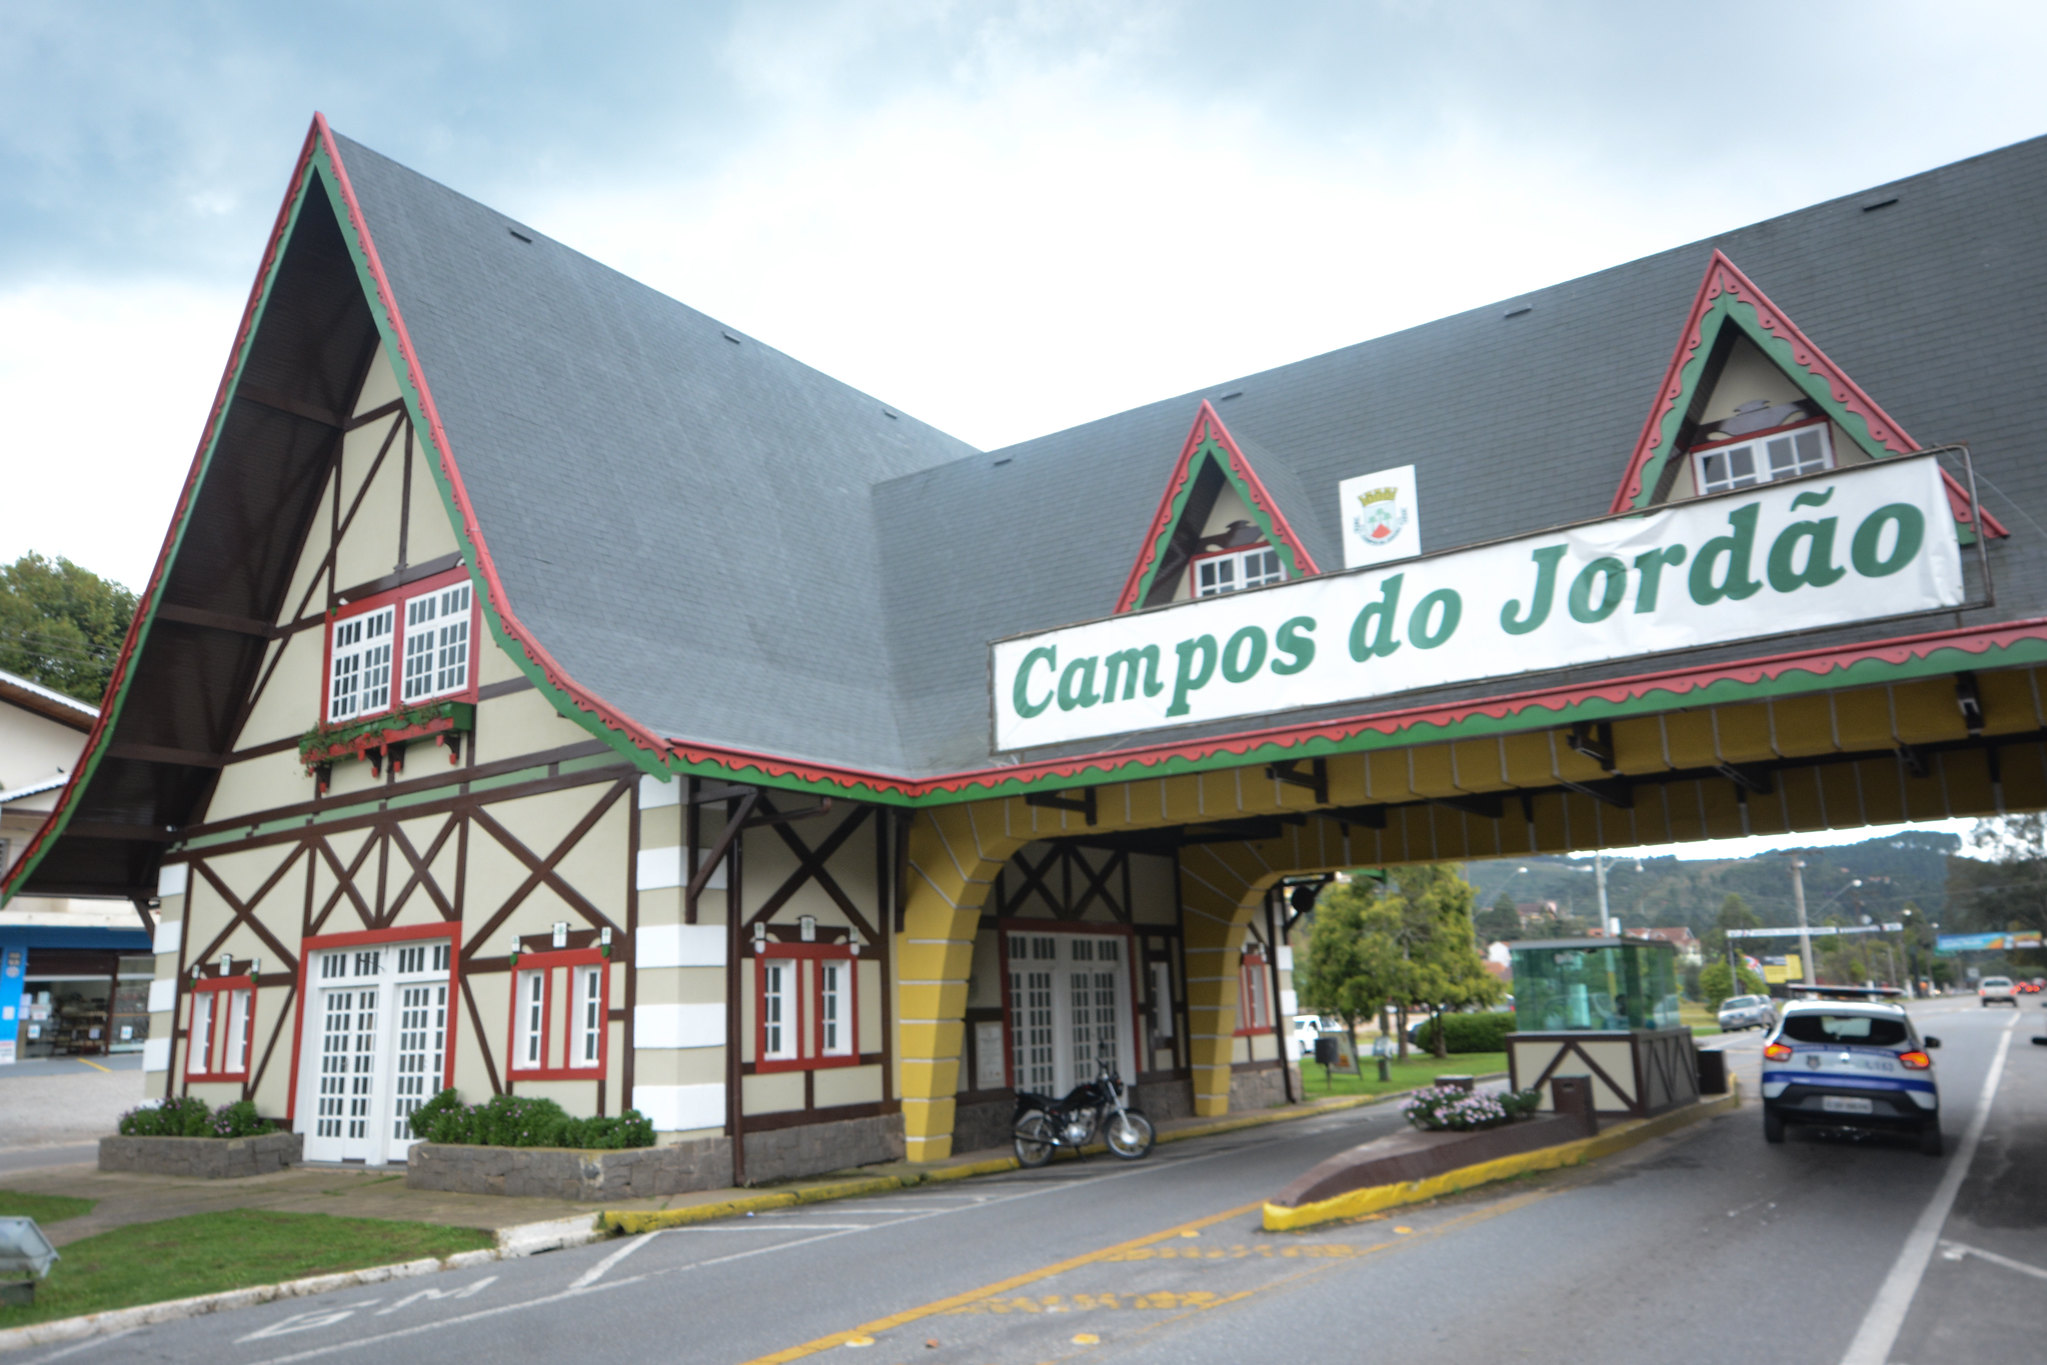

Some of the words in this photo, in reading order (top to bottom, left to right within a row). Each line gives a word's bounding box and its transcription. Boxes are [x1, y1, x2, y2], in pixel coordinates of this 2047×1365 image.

[1012, 618, 1317, 719] Campos
[1348, 573, 1462, 663] do
[1499, 486, 1925, 635] Jordão
